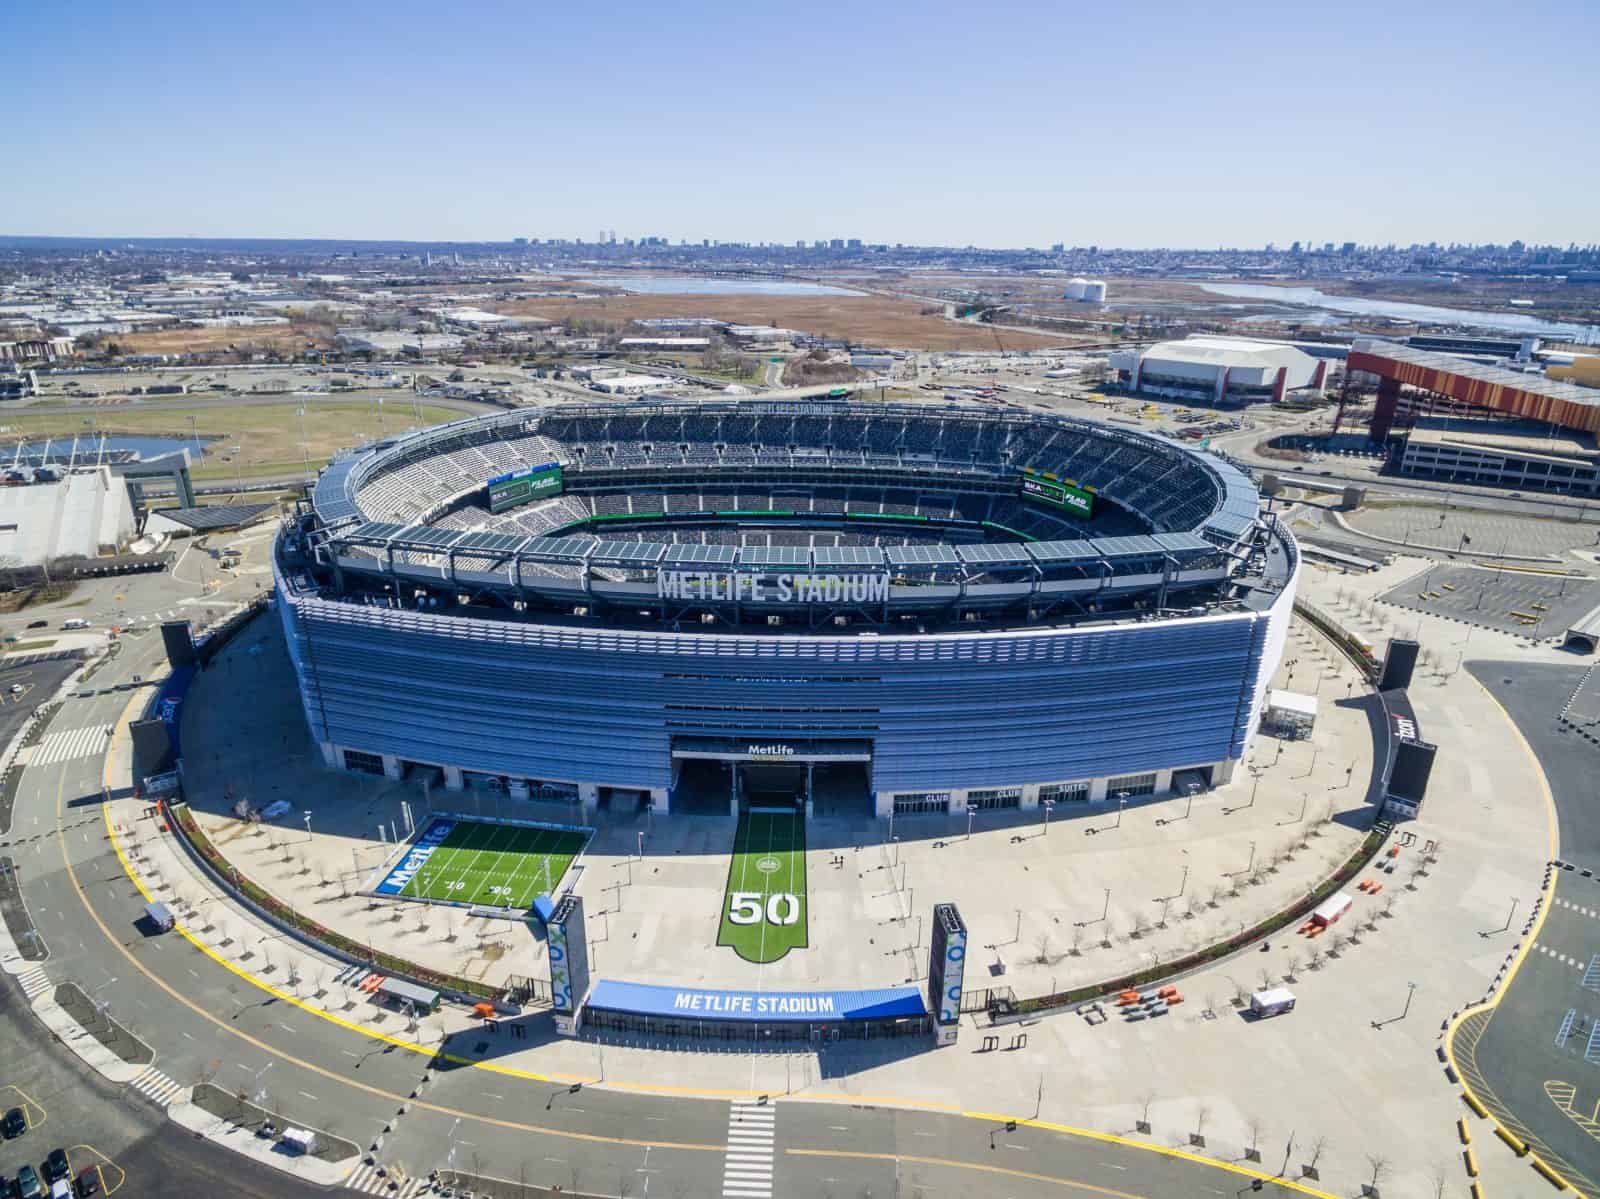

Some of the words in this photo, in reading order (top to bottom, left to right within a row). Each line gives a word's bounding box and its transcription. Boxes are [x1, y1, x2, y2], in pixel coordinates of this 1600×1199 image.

[657, 571, 766, 600] METLIFE
[776, 573, 889, 602] STADIUM
[748, 744, 794, 756] MetLife
[728, 891, 799, 926] 50
[674, 992, 751, 1012] METLIFE
[757, 996, 834, 1013] STADIUM
